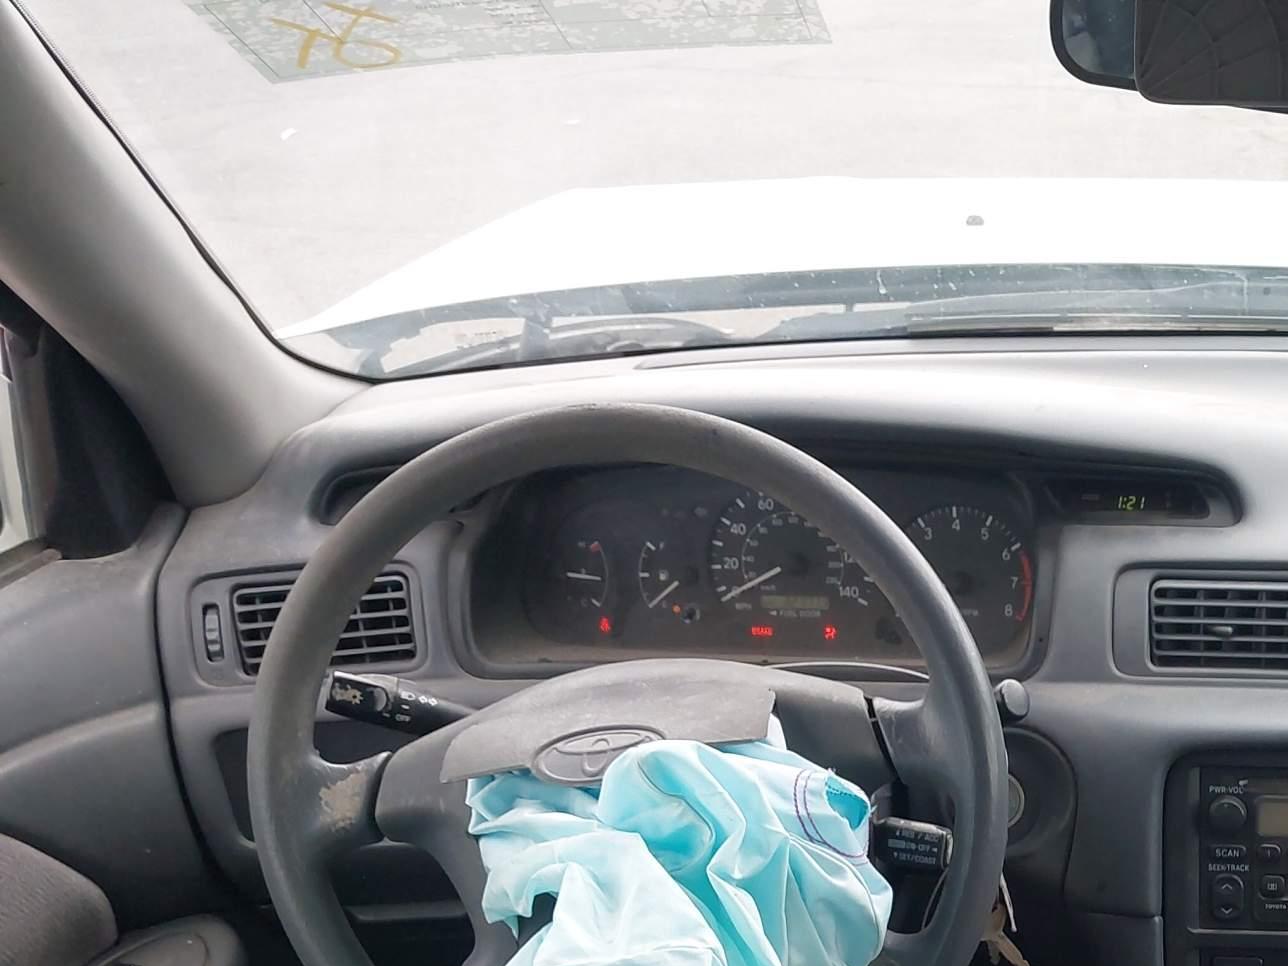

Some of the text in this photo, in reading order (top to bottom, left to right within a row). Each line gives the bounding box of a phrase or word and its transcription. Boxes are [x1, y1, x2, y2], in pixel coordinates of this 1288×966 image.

[758, 498, 774, 511] 60
[1117, 495, 1146, 510] 1:21
[729, 522, 747, 536] 40
[951, 518, 961, 531] 4
[924, 528, 933, 540] 3
[980, 527, 989, 540] 5
[1001, 547, 1011, 560] 6
[723, 556, 740, 570] 20
[1010, 576, 1018, 589] 7
[840, 586, 860, 598] 140
[1004, 603, 1014, 617] 8
[1215, 848, 1240, 858] SCAN
